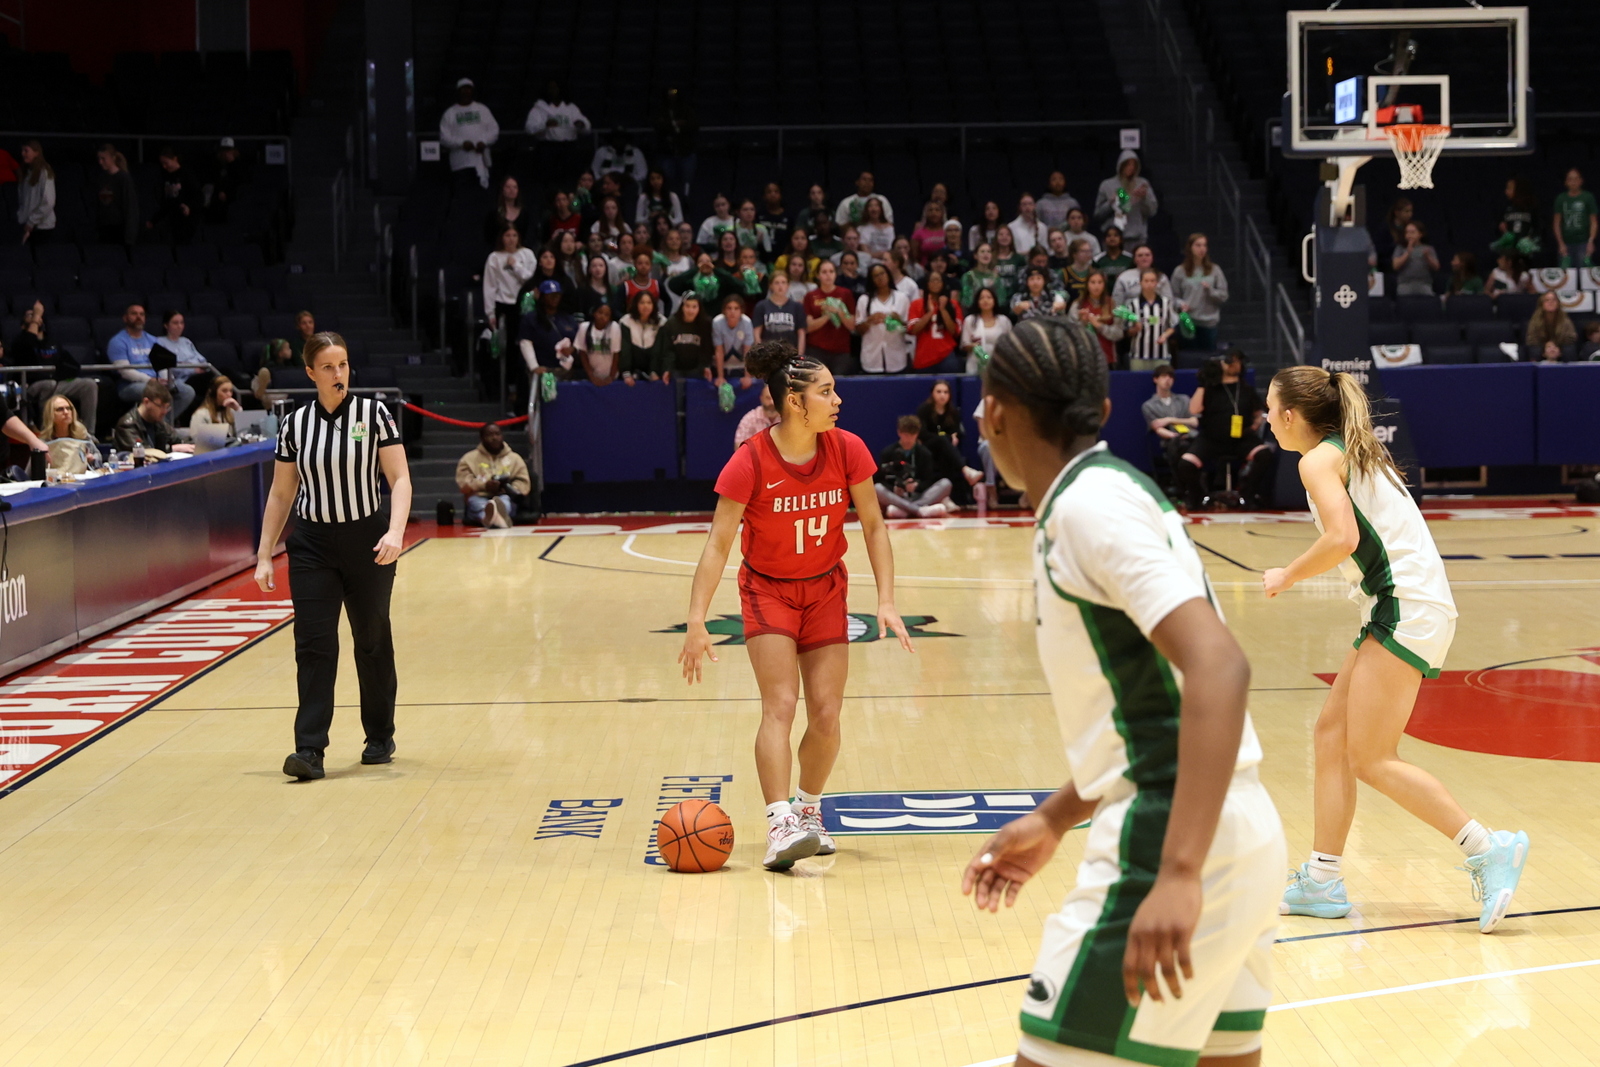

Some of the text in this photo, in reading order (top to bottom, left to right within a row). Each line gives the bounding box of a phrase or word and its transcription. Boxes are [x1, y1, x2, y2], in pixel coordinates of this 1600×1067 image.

[1321, 357, 1373, 372] Premier
[773, 488, 843, 512] BELLEVUE
[794, 515, 829, 554] 14
[0, 574, 28, 630] ton
[54, 599, 294, 664] COURT
[534, 798, 624, 840] BANK
